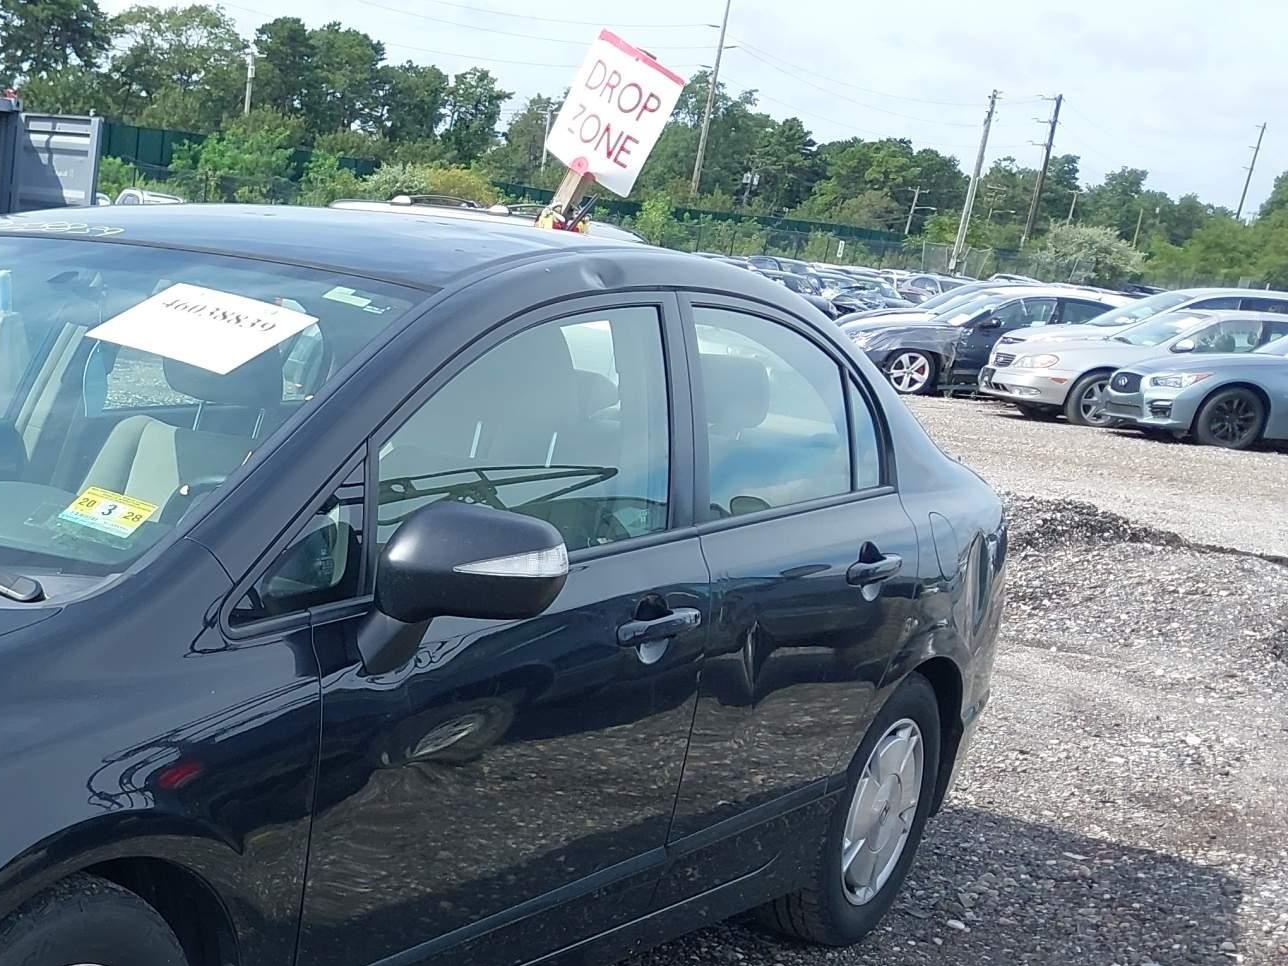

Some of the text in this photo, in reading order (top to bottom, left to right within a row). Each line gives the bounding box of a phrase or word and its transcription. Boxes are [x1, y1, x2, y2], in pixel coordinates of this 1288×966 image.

[585, 59, 661, 122] DROP
[568, 103, 640, 169] ZONE
[162, 298, 277, 332] 46038839
[78, 497, 97, 508] 20
[101, 504, 118, 516] 3
[122, 511, 143, 522] 28
